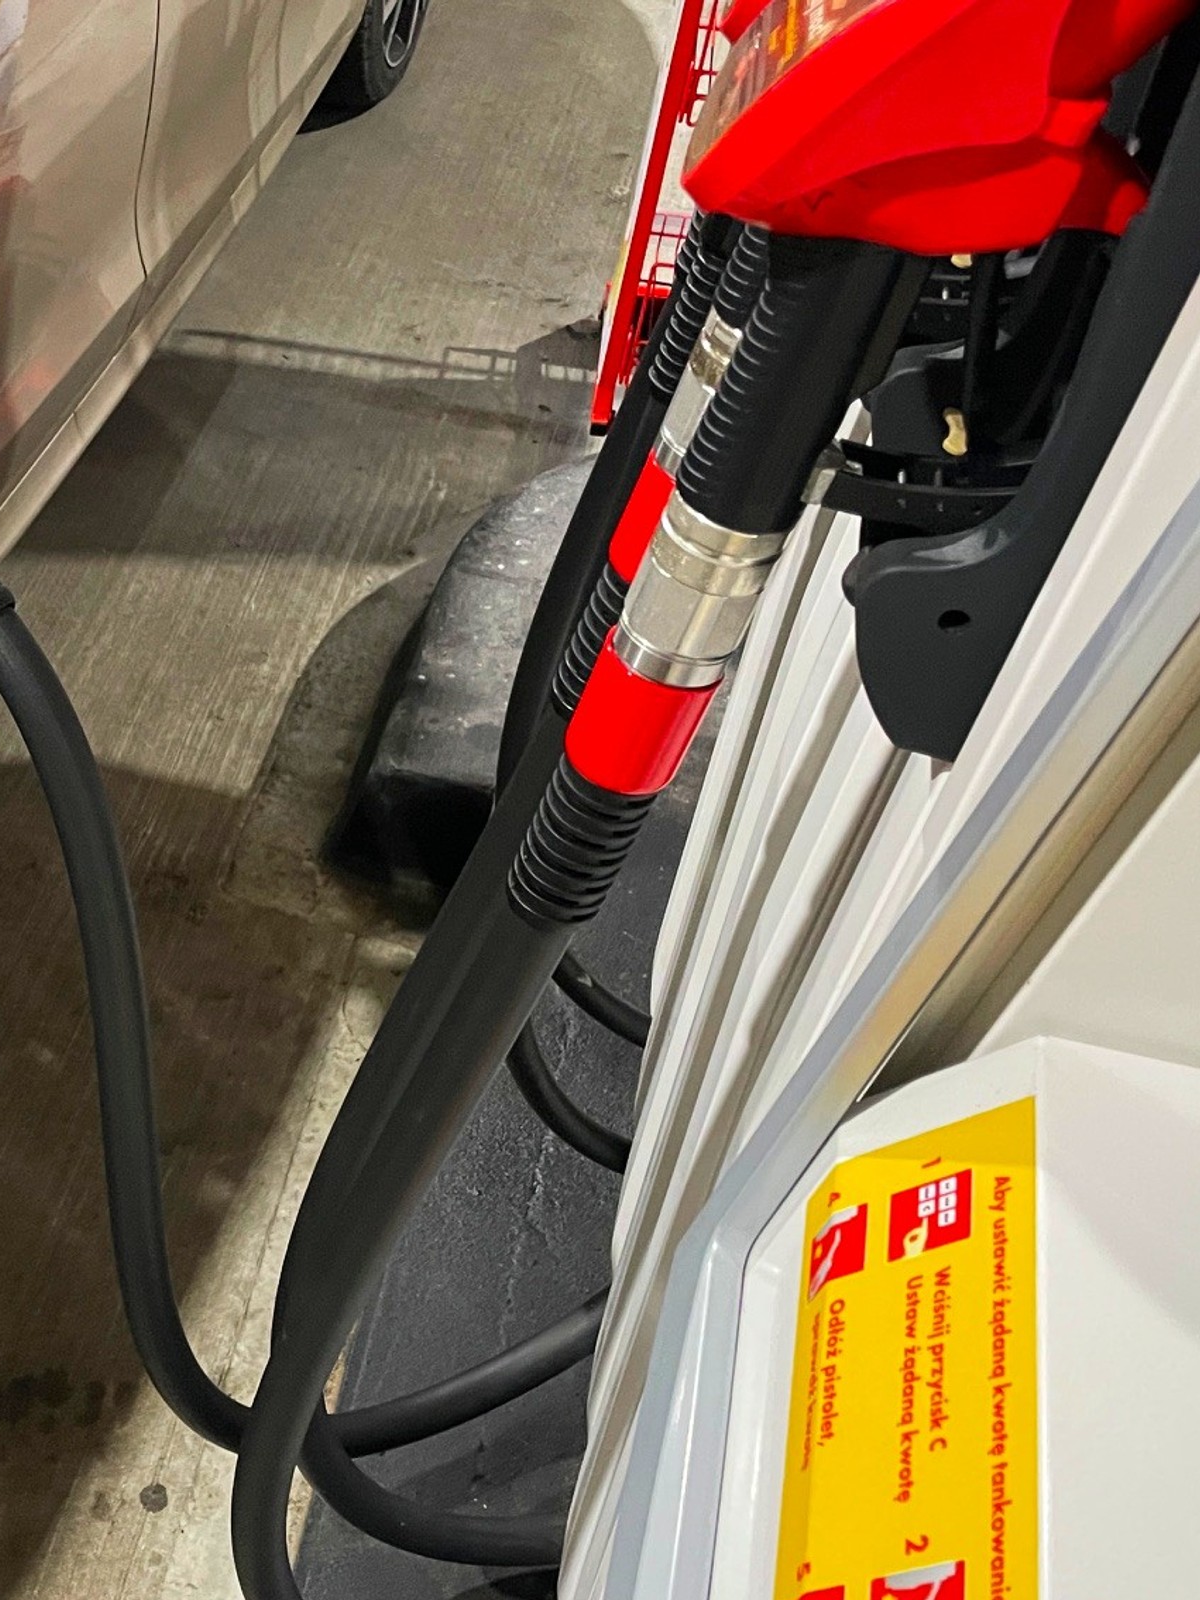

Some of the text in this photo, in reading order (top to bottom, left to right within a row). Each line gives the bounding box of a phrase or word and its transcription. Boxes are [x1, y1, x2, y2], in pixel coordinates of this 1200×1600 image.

[921, 1156, 942, 1169] 1
[988, 1176, 1012, 1212] Aby
[993, 1217, 1012, 1294] ustawić
[817, 1298, 845, 1447] Odłóż pistolet,
[926, 1265, 951, 1452] Wciśnij przycisk C
[988, 1298, 1012, 1380] żądaną
[893, 1274, 923, 1503] Ustaw żądaną kwotę
[987, 1382, 1012, 1456] kwotę
[905, 1534, 929, 1556] 2
